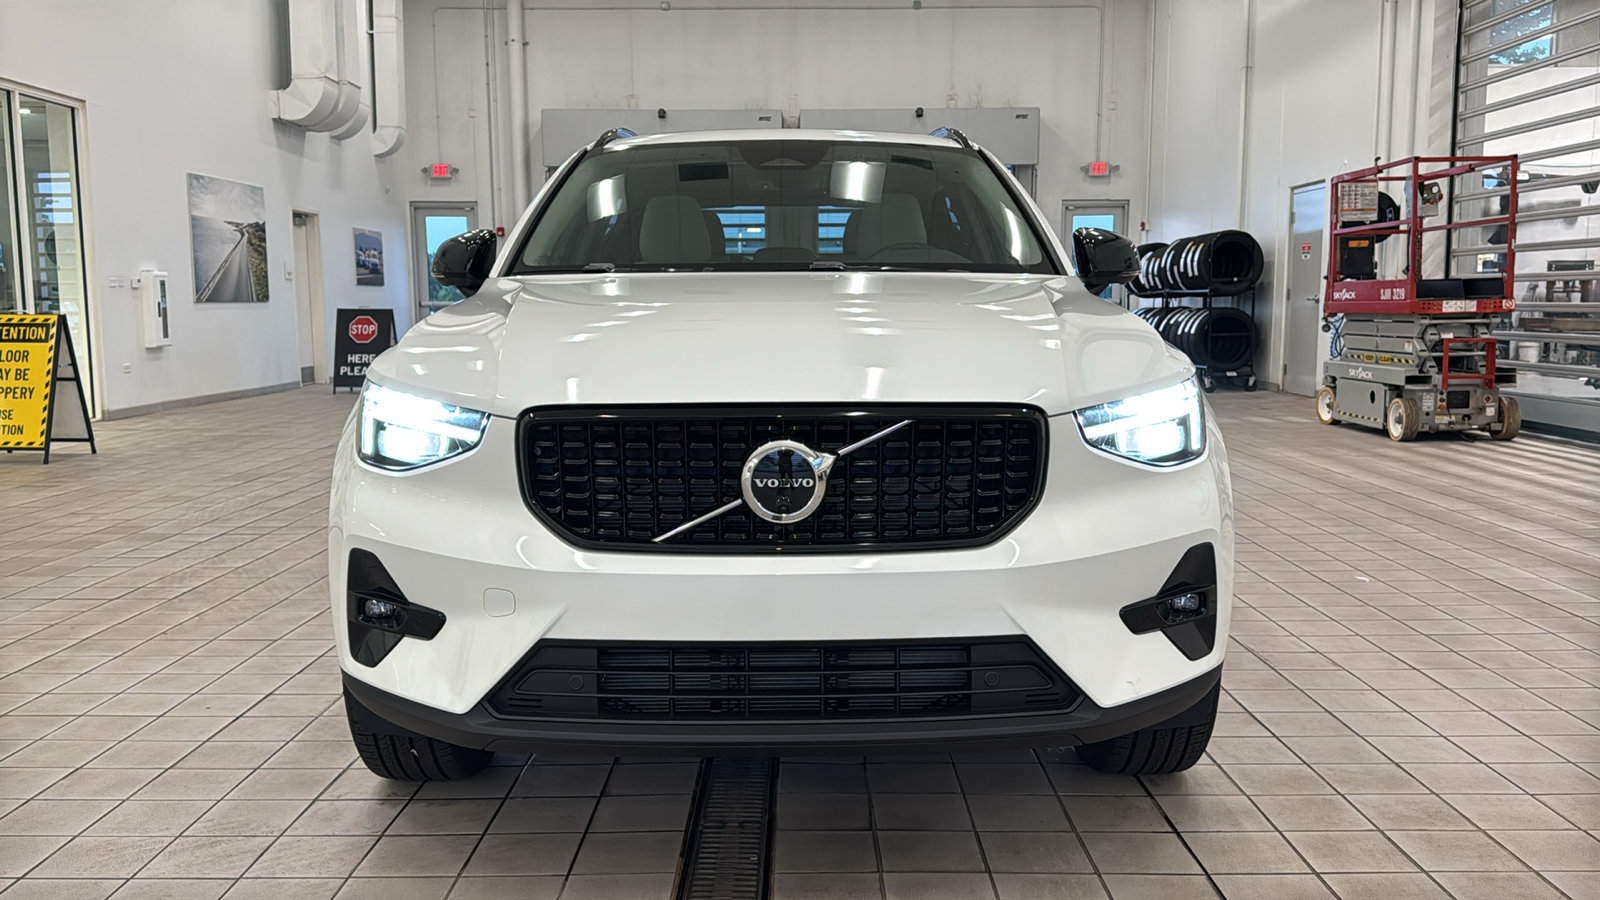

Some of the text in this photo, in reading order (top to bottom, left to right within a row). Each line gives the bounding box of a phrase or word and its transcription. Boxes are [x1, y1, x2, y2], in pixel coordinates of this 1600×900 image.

[432, 164, 448, 177] EXIT
[1091, 161, 1107, 175] EXIT
[1333, 288, 1356, 301] SKYJACK
[0, 326, 46, 340] ENTION
[351, 324, 376, 335] STOP
[0, 349, 29, 363] LOOR
[14, 367, 30, 381] BE
[340, 366, 367, 376] PLEA
[0, 386, 35, 400] PPERY
[0, 409, 14, 420] SE
[1, 424, 24, 435] TION
[753, 478, 814, 488] VOLVO
